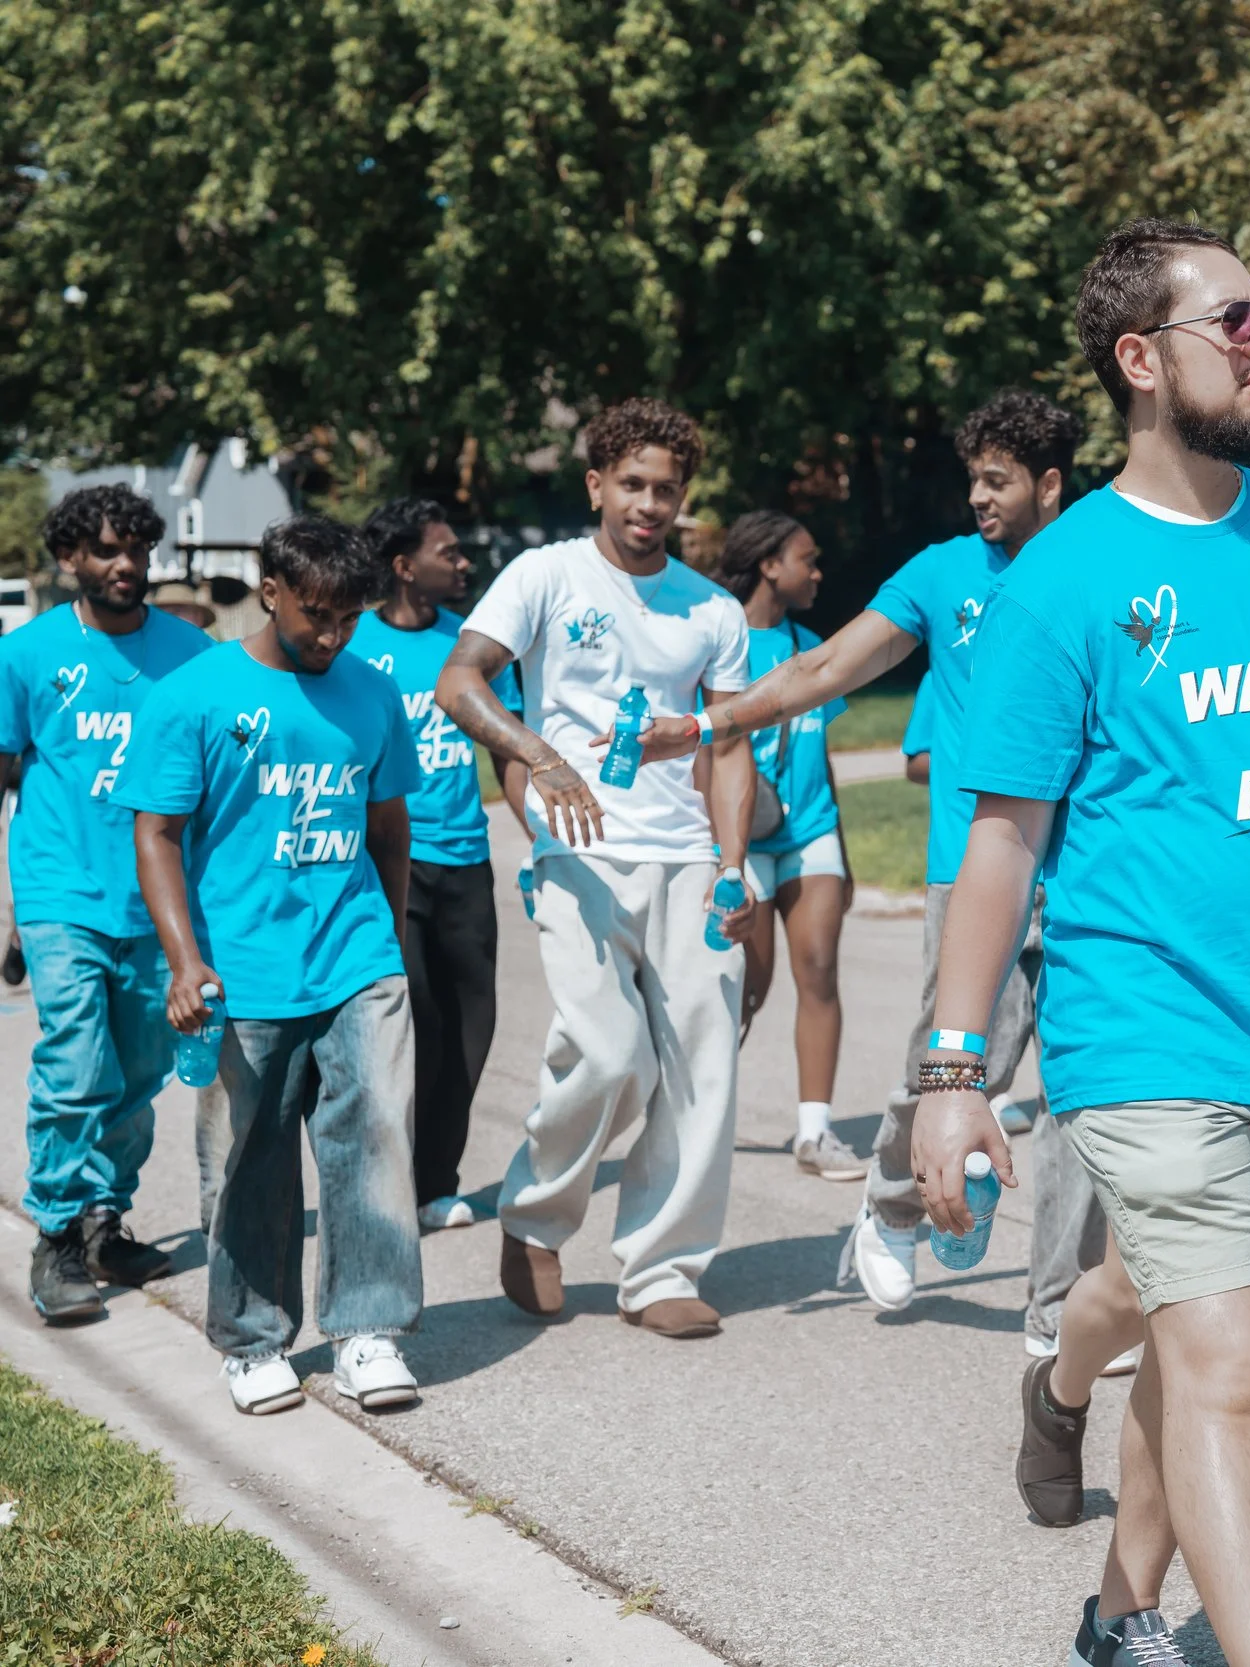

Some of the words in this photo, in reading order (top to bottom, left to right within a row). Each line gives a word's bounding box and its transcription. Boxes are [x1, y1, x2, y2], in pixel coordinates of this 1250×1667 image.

[258, 763, 364, 796] WALK
[292, 786, 332, 835] 4
[273, 830, 361, 869] RONI
